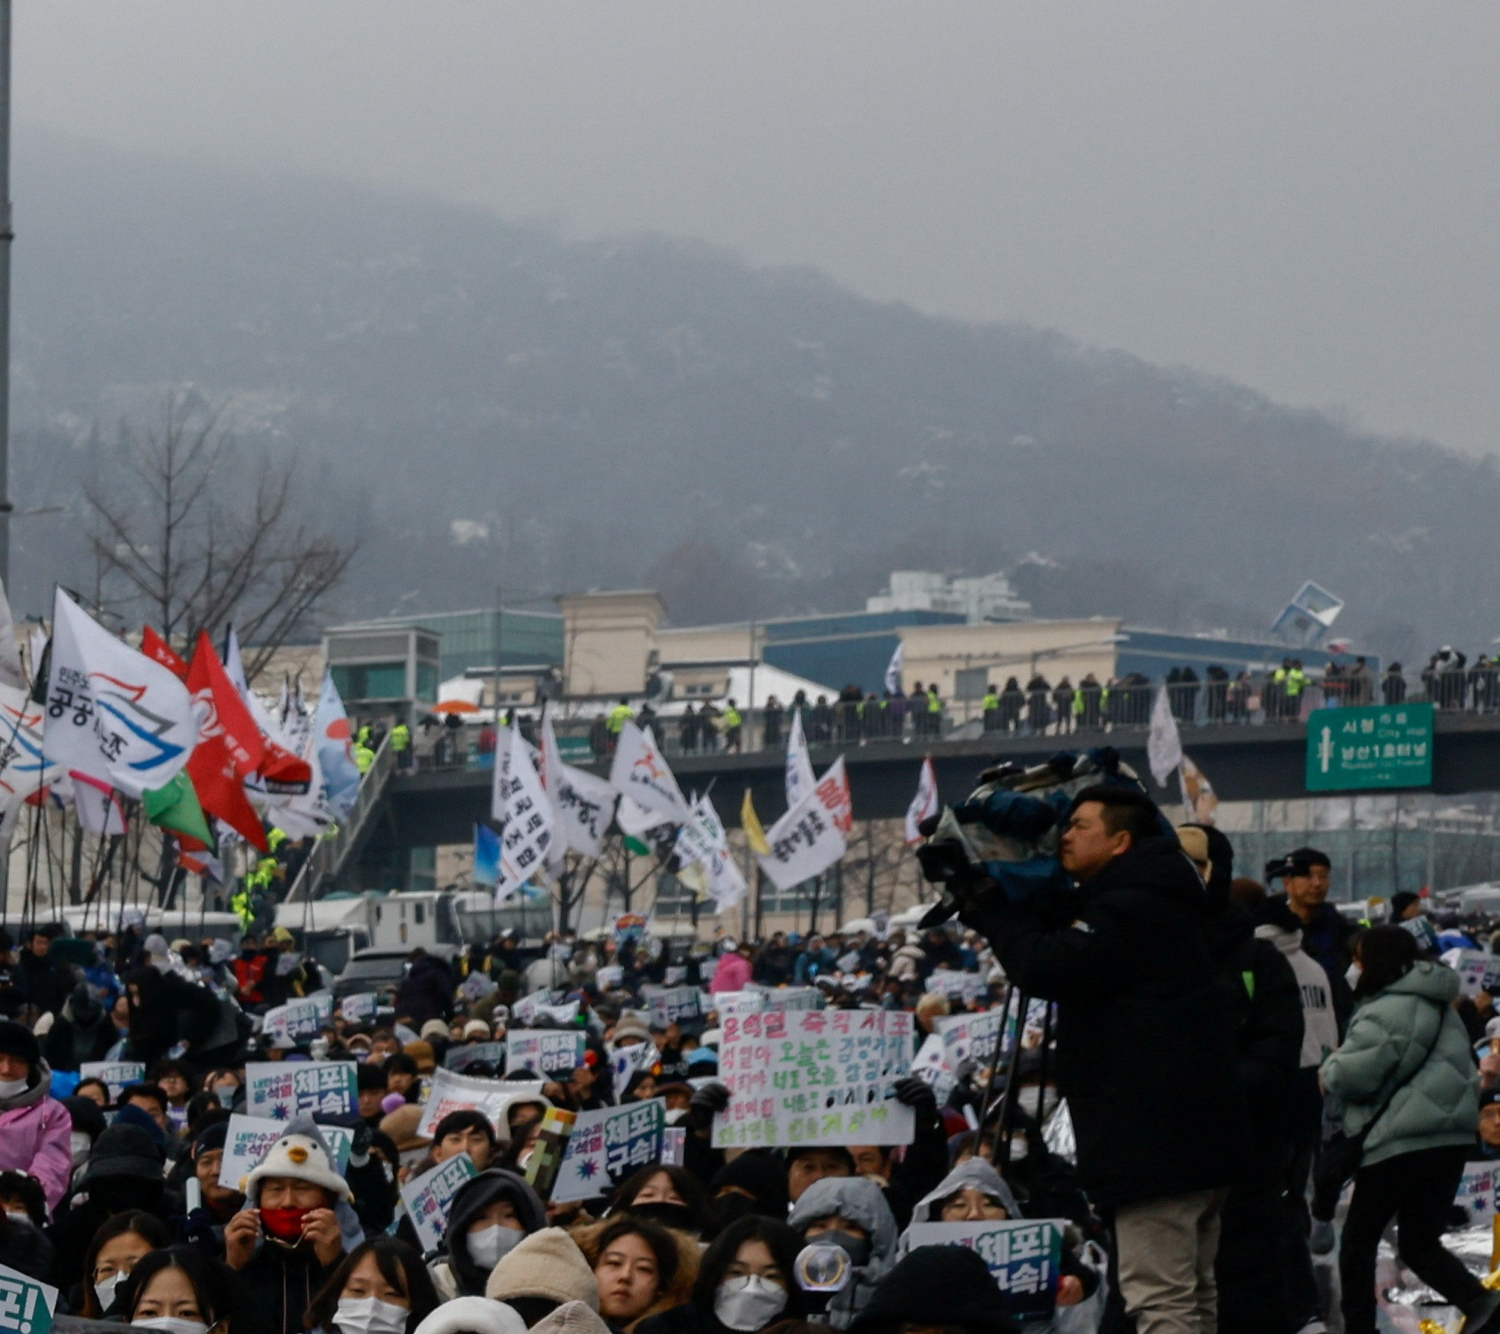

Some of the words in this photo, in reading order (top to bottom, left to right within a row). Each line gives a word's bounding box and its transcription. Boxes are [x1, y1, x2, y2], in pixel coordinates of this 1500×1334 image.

[294, 1063, 350, 1095] 체포!
[605, 1101, 660, 1141] 체포!
[606, 1137, 660, 1176] 구속!
[978, 1223, 1053, 1261] 체포!
